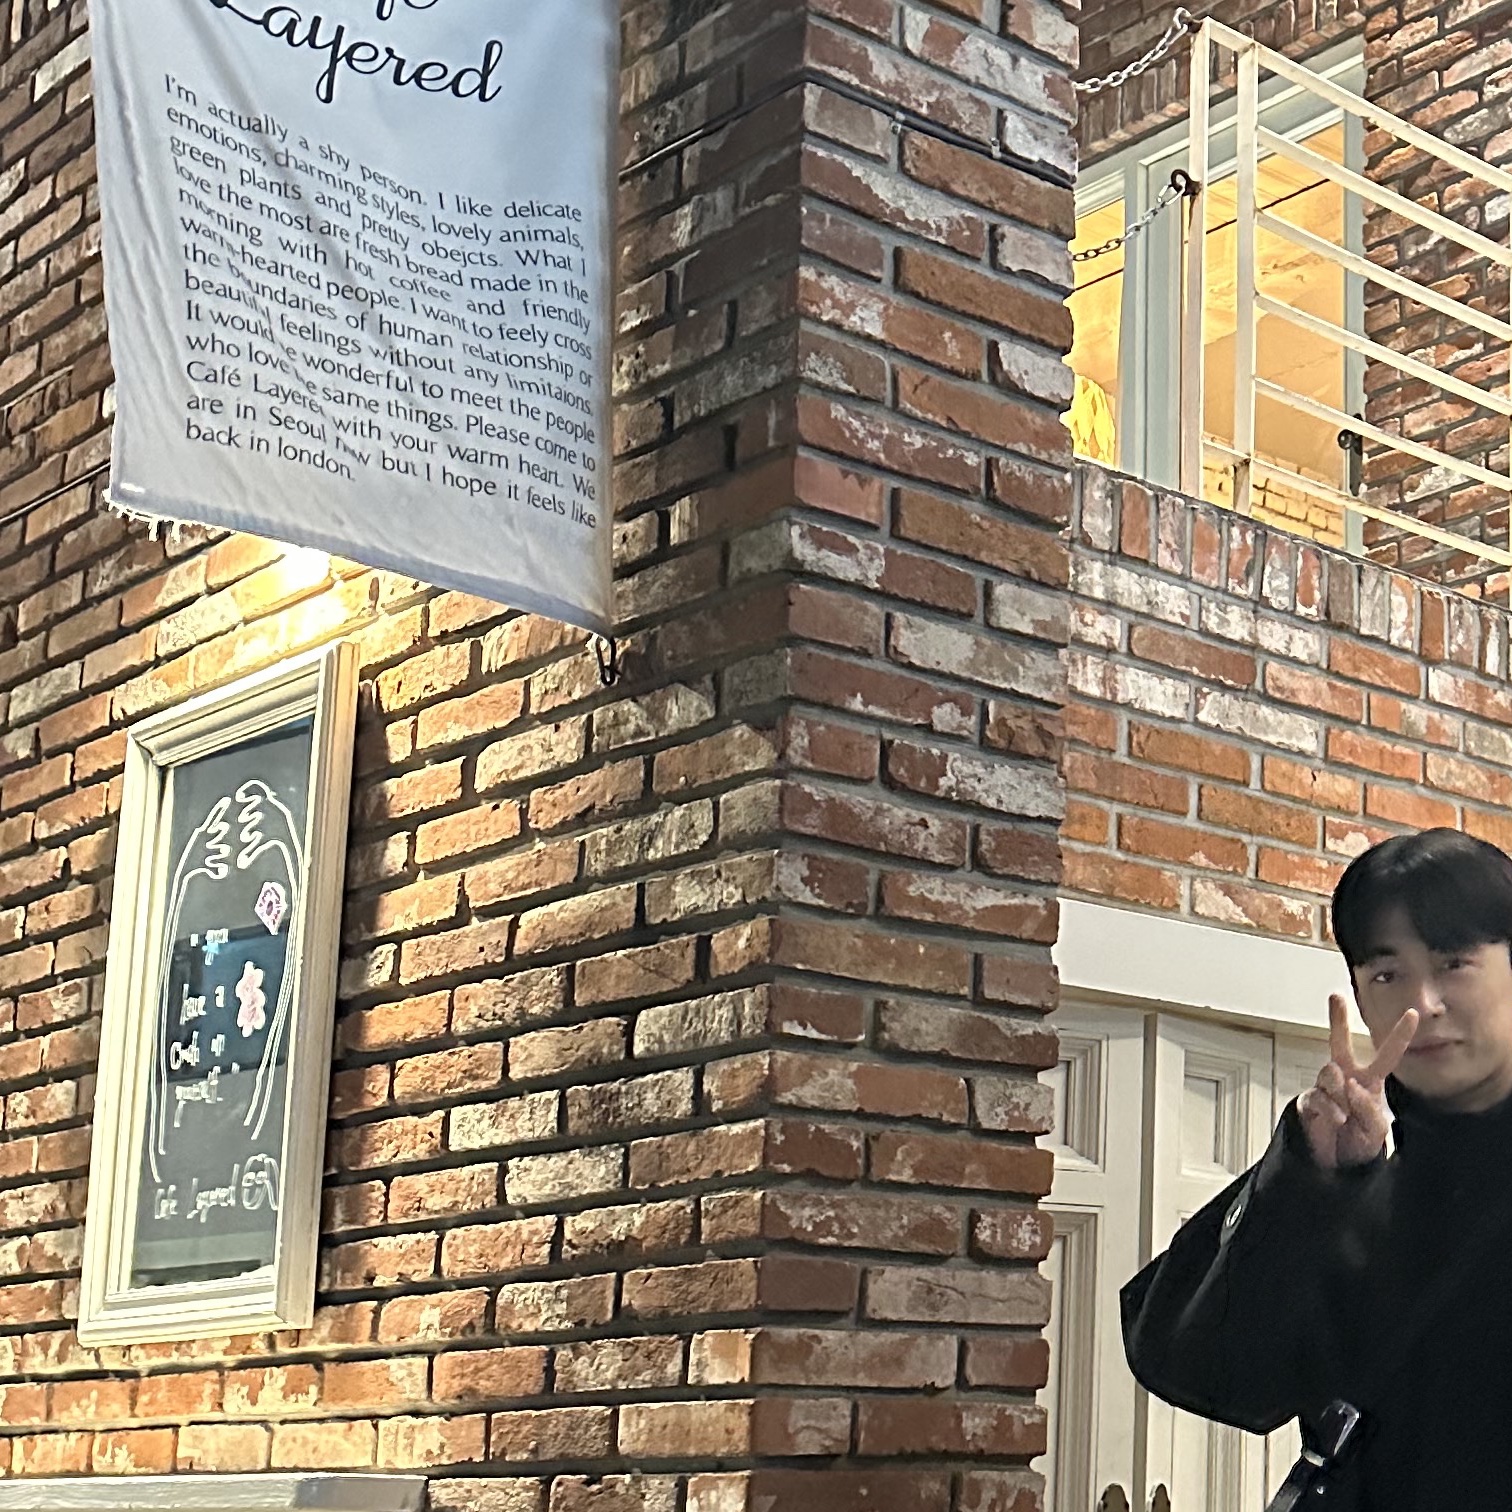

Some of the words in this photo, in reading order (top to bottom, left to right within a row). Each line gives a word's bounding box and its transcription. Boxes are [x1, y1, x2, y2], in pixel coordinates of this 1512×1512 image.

[210, 0, 503, 103] ayered
[165, 73, 197, 106] I'm
[208, 101, 288, 142] actually
[299, 135, 310, 151] a
[319, 144, 350, 172] shy
[360, 163, 427, 206] person.
[438, 192, 445, 210] I
[455, 194, 493, 217] like
[503, 200, 582, 222] delicate
[167, 106, 267, 167] emotions,
[274, 148, 368, 206] charming
[371, 192, 426, 232] styles,
[431, 215, 492, 246] lovely
[499, 224, 584, 251] animals,
[170, 136, 227, 174] green
[240, 166, 302, 200] plants
[315, 192, 352, 218] and
[361, 213, 410, 251] pretty
[421, 240, 503, 268] obejcts.
[515, 250, 573, 272] What
[581, 258, 587, 277] I
[173, 156, 211, 194] love
[218, 183, 253, 211] the
[259, 200, 313, 233] most
[319, 219, 350, 243] are
[356, 232, 400, 268] fresh
[405, 255, 464, 286] bread
[470, 274, 531, 292] made
[538, 273, 558, 294] in
[564, 280, 589, 304] the
[179, 187, 263, 247] morning
[278, 236, 327, 265] with
[344, 250, 375, 280] hot
[389, 275, 451, 300] coffee
[466, 298, 506, 317] and
[522, 298, 591, 335] friendly
[184, 243, 221, 268] the
[345, 311, 369, 332] of
[379, 313, 454, 348] human
[462, 342, 574, 381] relationship
[579, 369, 594, 387] or
[187, 299, 202, 321] It
[209, 308, 275, 344] would
[302, 351, 414, 393] wonderful
[421, 380, 444, 399] to
[450, 386, 503, 413] meet
[510, 398, 541, 421] the
[546, 410, 596, 445] people
[280, 313, 362, 356] feelings
[368, 344, 456, 374] without
[464, 364, 499, 388] any
[326, 280, 405, 311] people.
[411, 297, 417, 314] I
[422, 303, 469, 334] want
[473, 322, 493, 340] to
[499, 323, 549, 348] feely
[554, 332, 592, 361] cross
[186, 333, 241, 358] who
[249, 341, 290, 374] love
[294, 366, 318, 395] he
[322, 386, 379, 414] same
[387, 401, 458, 432] things.
[466, 414, 530, 447] Please
[535, 436, 578, 465] come
[583, 452, 596, 472] to
[186, 361, 242, 388] Café
[333, 415, 381, 441] with
[390, 431, 438, 454] your
[448, 444, 509, 470] warm
[519, 454, 564, 488] heart.
[573, 473, 596, 501] We
[186, 418, 241, 448] back
[250, 430, 269, 454] in
[278, 437, 356, 482] london.
[187, 394, 224, 415] are
[236, 397, 257, 421] in
[269, 406, 326, 443] Seoul
[381, 451, 418, 476] but
[426, 463, 431, 482] I
[442, 465, 497, 496] hope
[508, 479, 520, 501] it
[527, 486, 566, 516] feels
[571, 500, 596, 528] like
